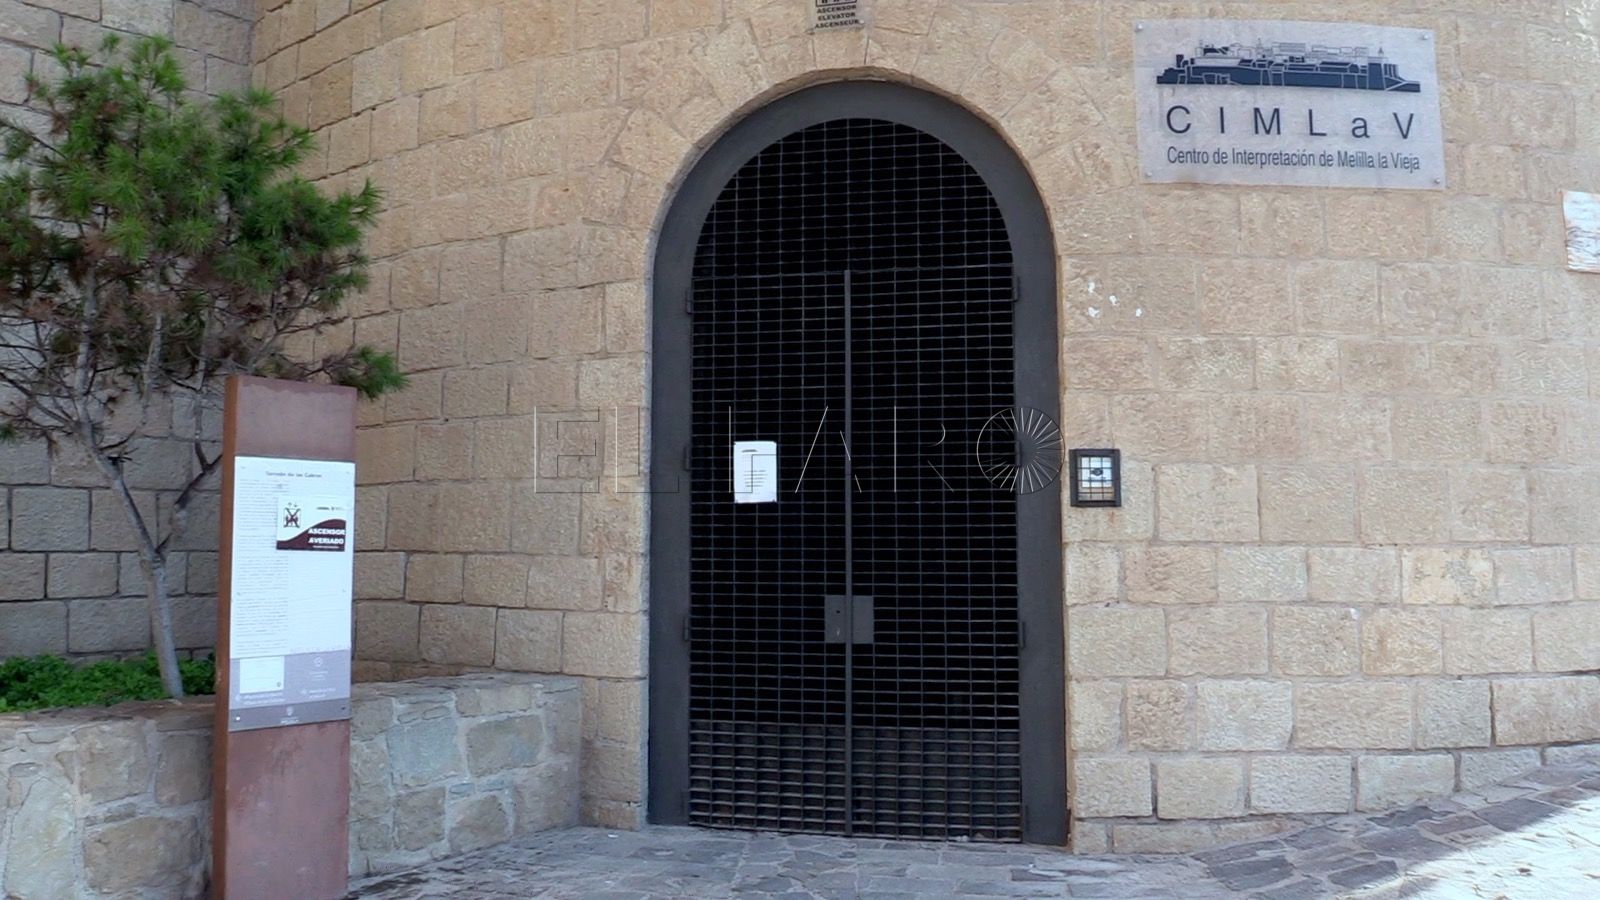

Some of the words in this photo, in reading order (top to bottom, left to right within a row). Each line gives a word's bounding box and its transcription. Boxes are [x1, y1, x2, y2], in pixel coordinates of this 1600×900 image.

[1167, 146, 1209, 164] Centro
[1212, 148, 1228, 165] de
[1232, 147, 1315, 169] Interpretación
[1319, 150, 1334, 167] de
[1337, 150, 1375, 168] Melilla
[1378, 152, 1389, 169] la
[1391, 152, 1420, 174] Vieja
